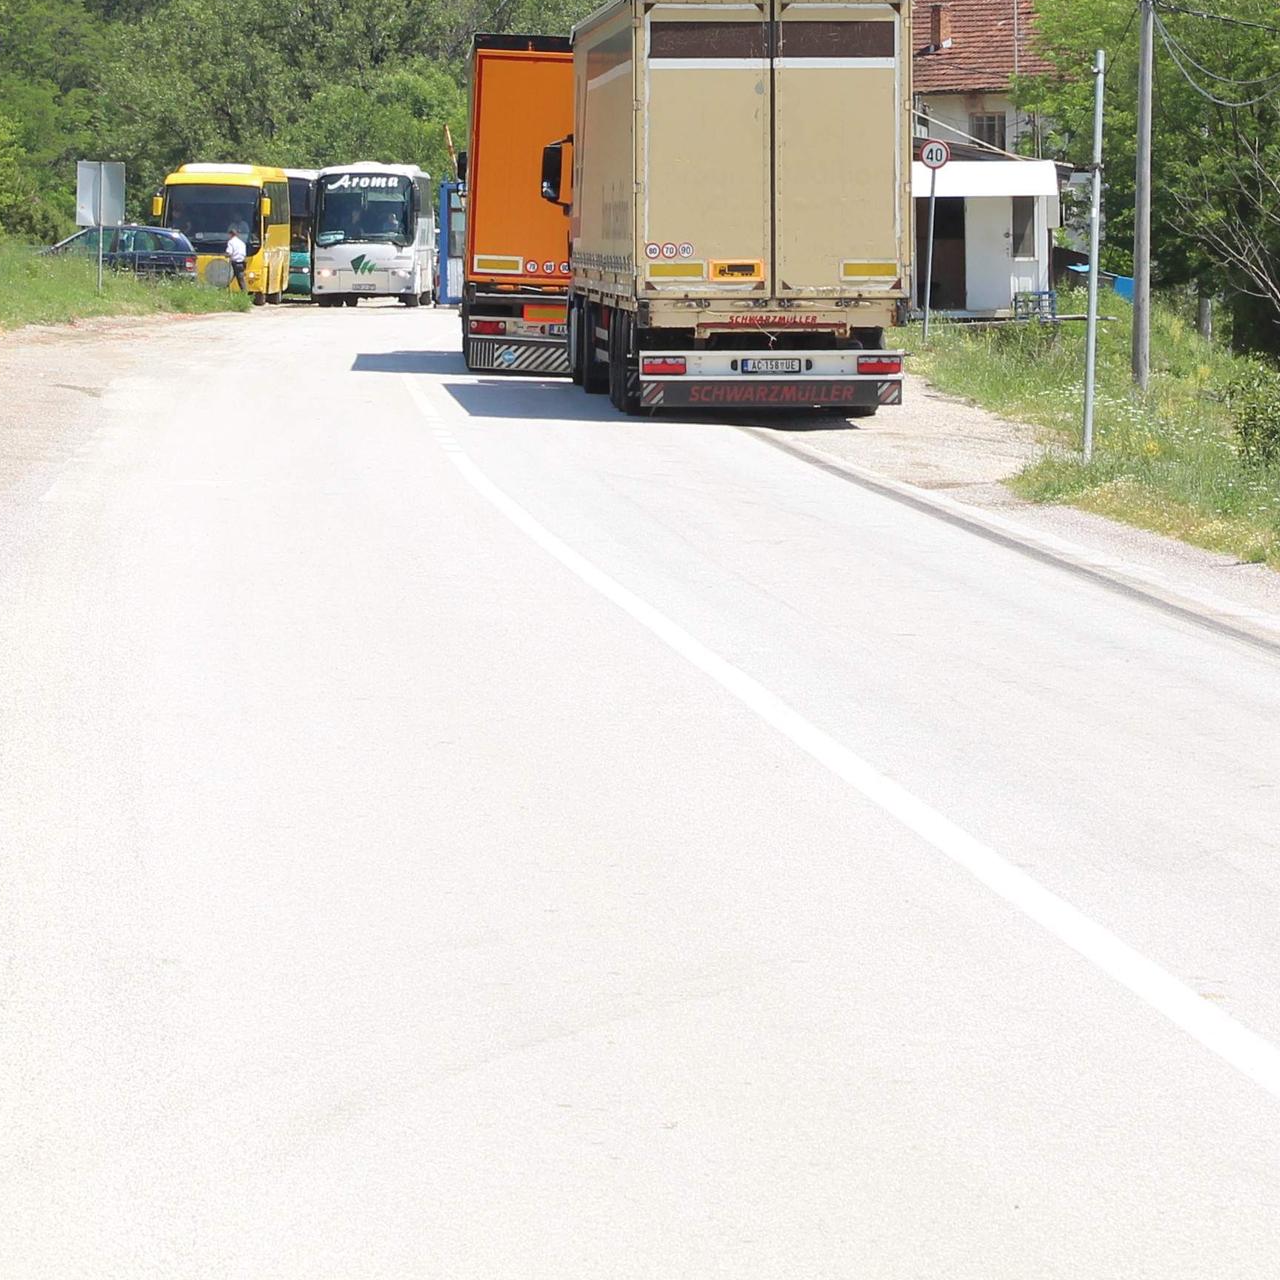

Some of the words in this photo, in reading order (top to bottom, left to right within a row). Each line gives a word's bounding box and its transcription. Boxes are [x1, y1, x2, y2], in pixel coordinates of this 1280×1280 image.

[926, 148, 943, 162] 40
[327, 174, 399, 190] Aroma
[665, 246, 675, 255] 70
[681, 246, 691, 255] 90
[688, 384, 856, 402] SCHWARZMÜLLER
